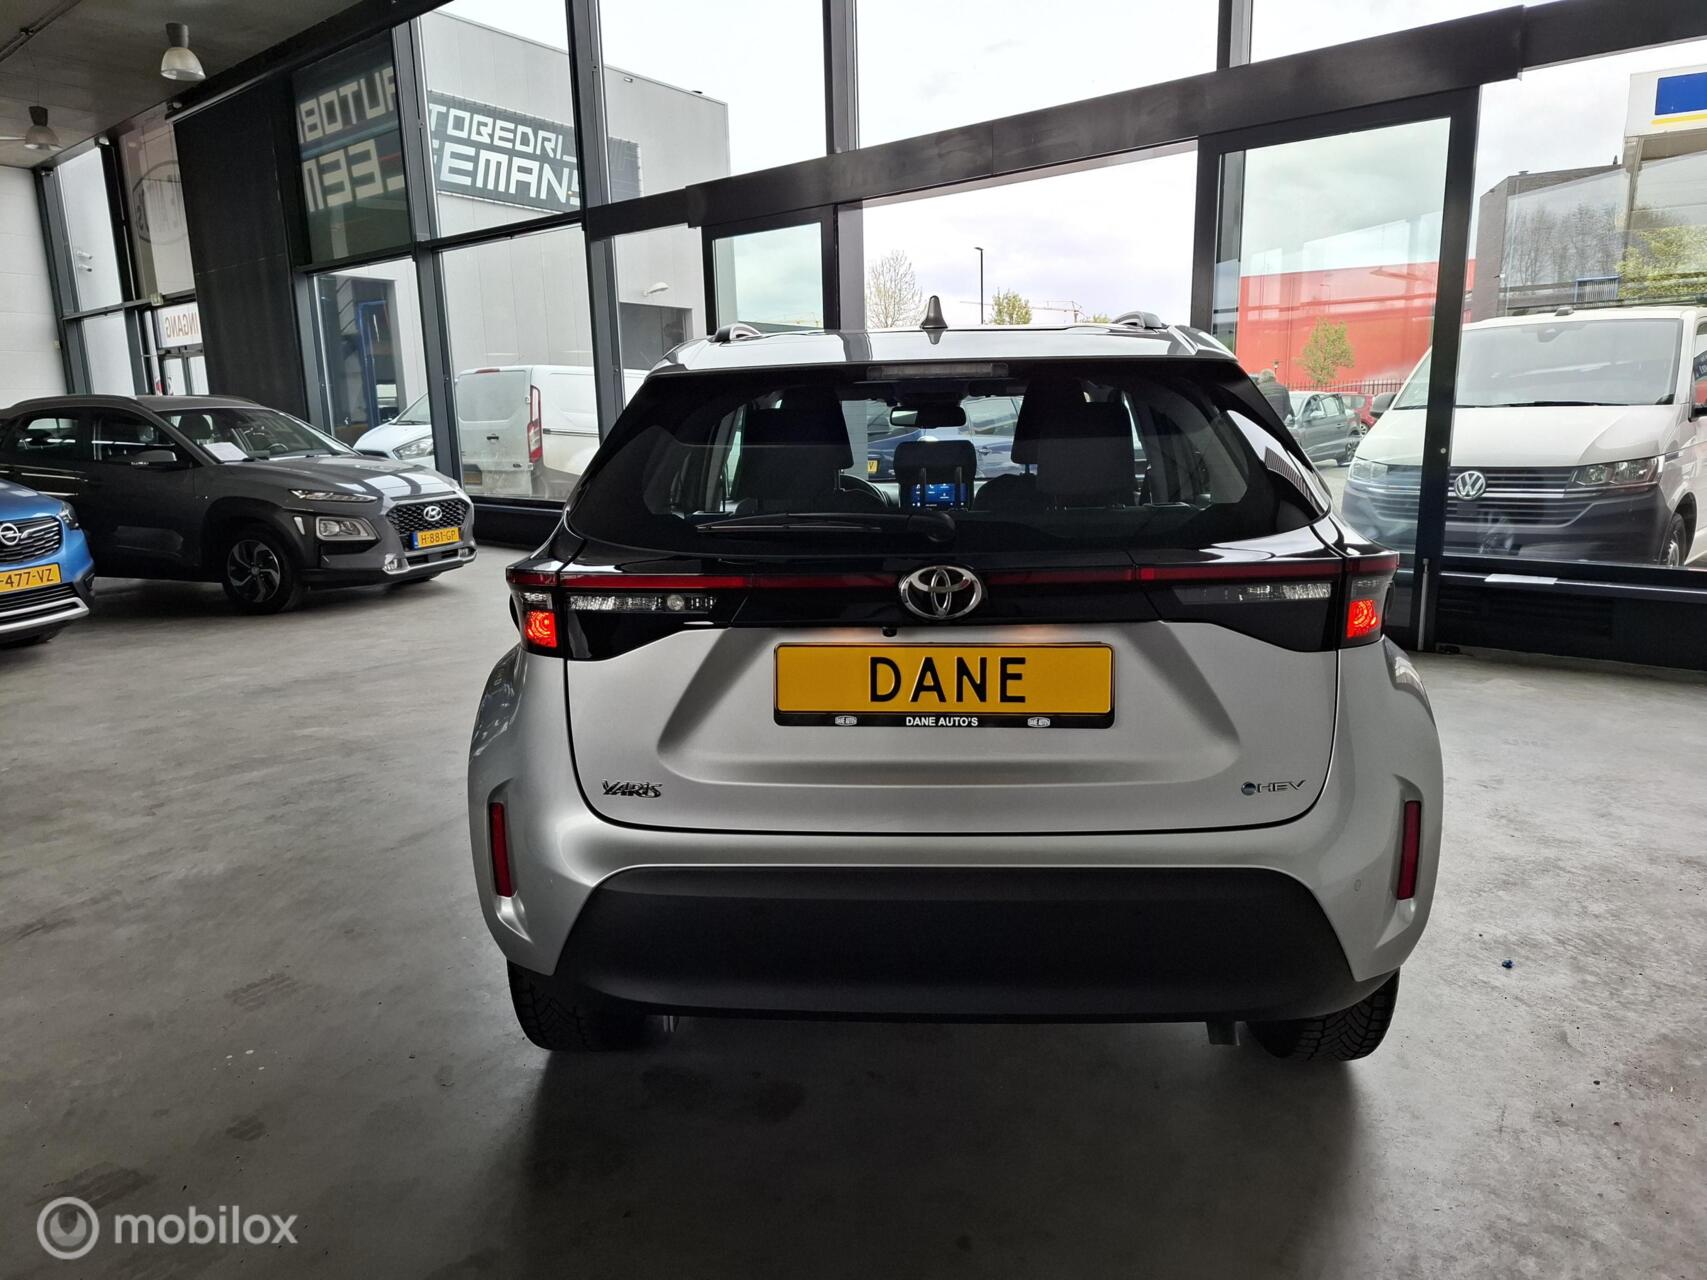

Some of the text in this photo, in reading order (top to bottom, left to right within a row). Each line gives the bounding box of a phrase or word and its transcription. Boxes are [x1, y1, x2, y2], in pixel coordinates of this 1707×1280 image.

[868, 656, 1027, 704] DANE
[905, 716, 979, 727] DANE AUTO'S
